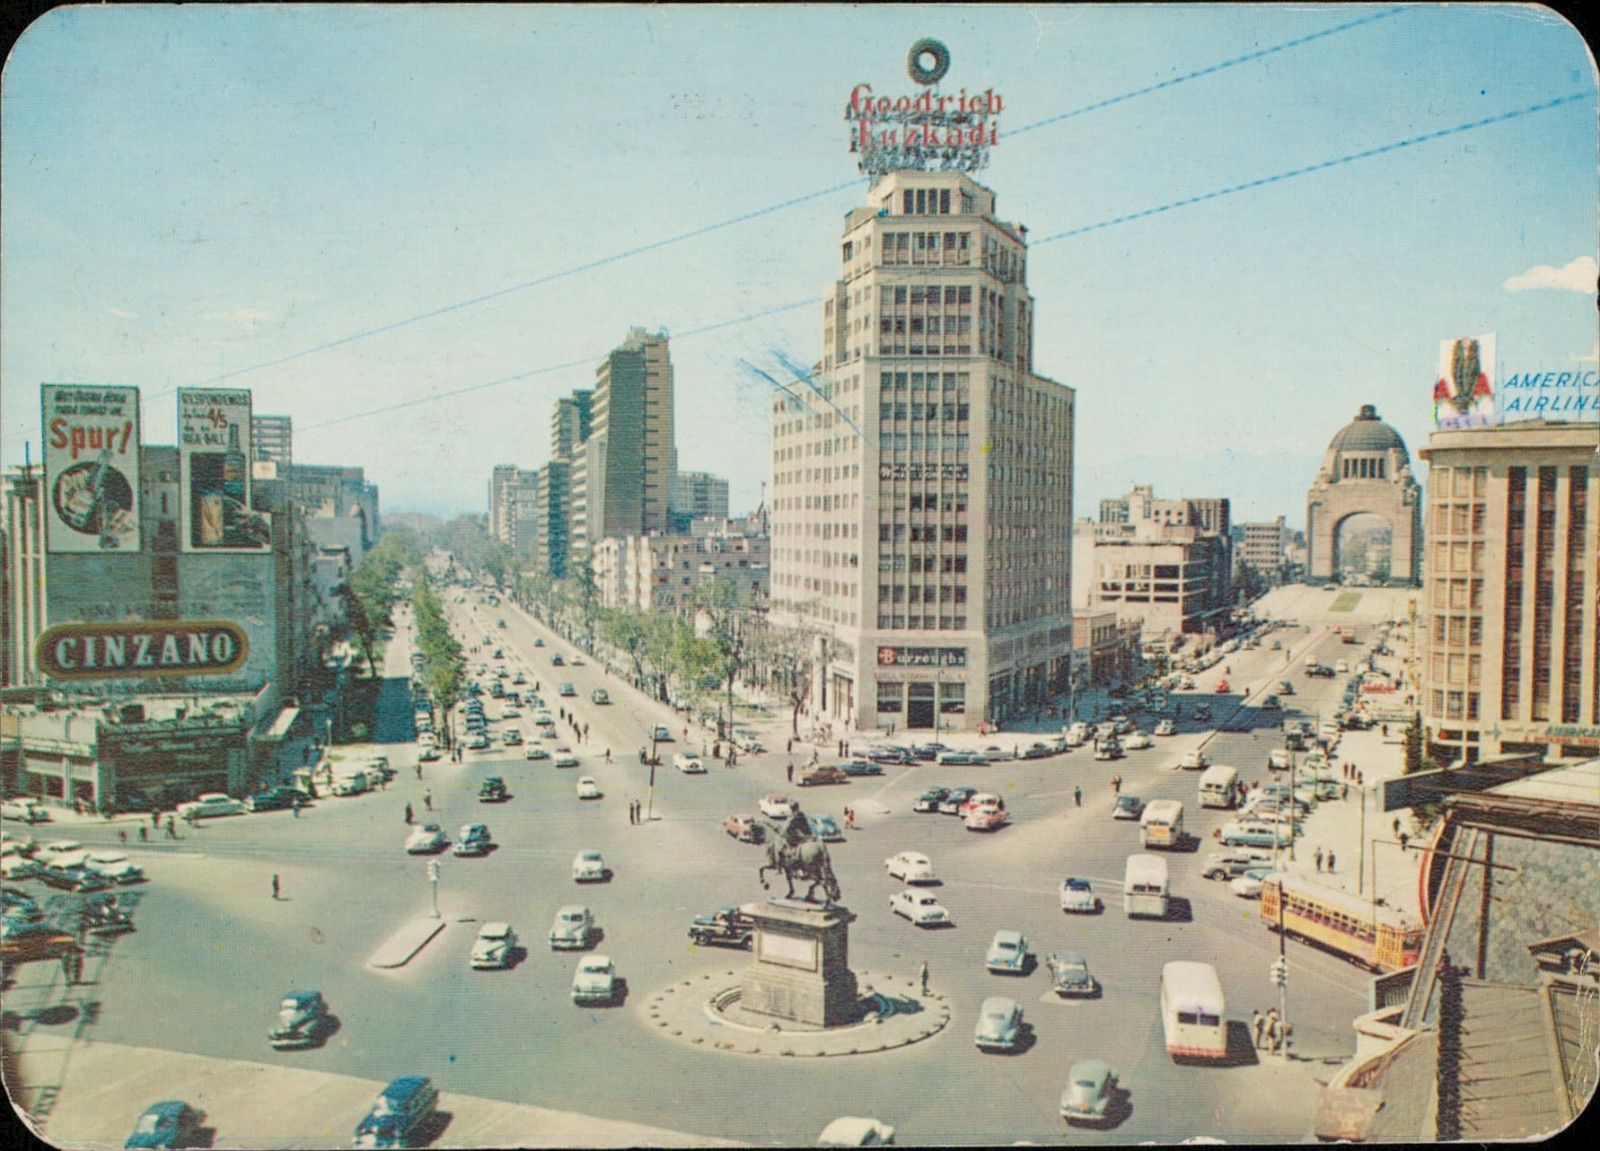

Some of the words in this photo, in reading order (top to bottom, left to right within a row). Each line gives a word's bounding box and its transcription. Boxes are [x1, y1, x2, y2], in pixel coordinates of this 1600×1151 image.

[850, 83, 1004, 114] Goodrich
[51, 418, 132, 459] Spur!
[56, 633, 236, 668] CINZANO
